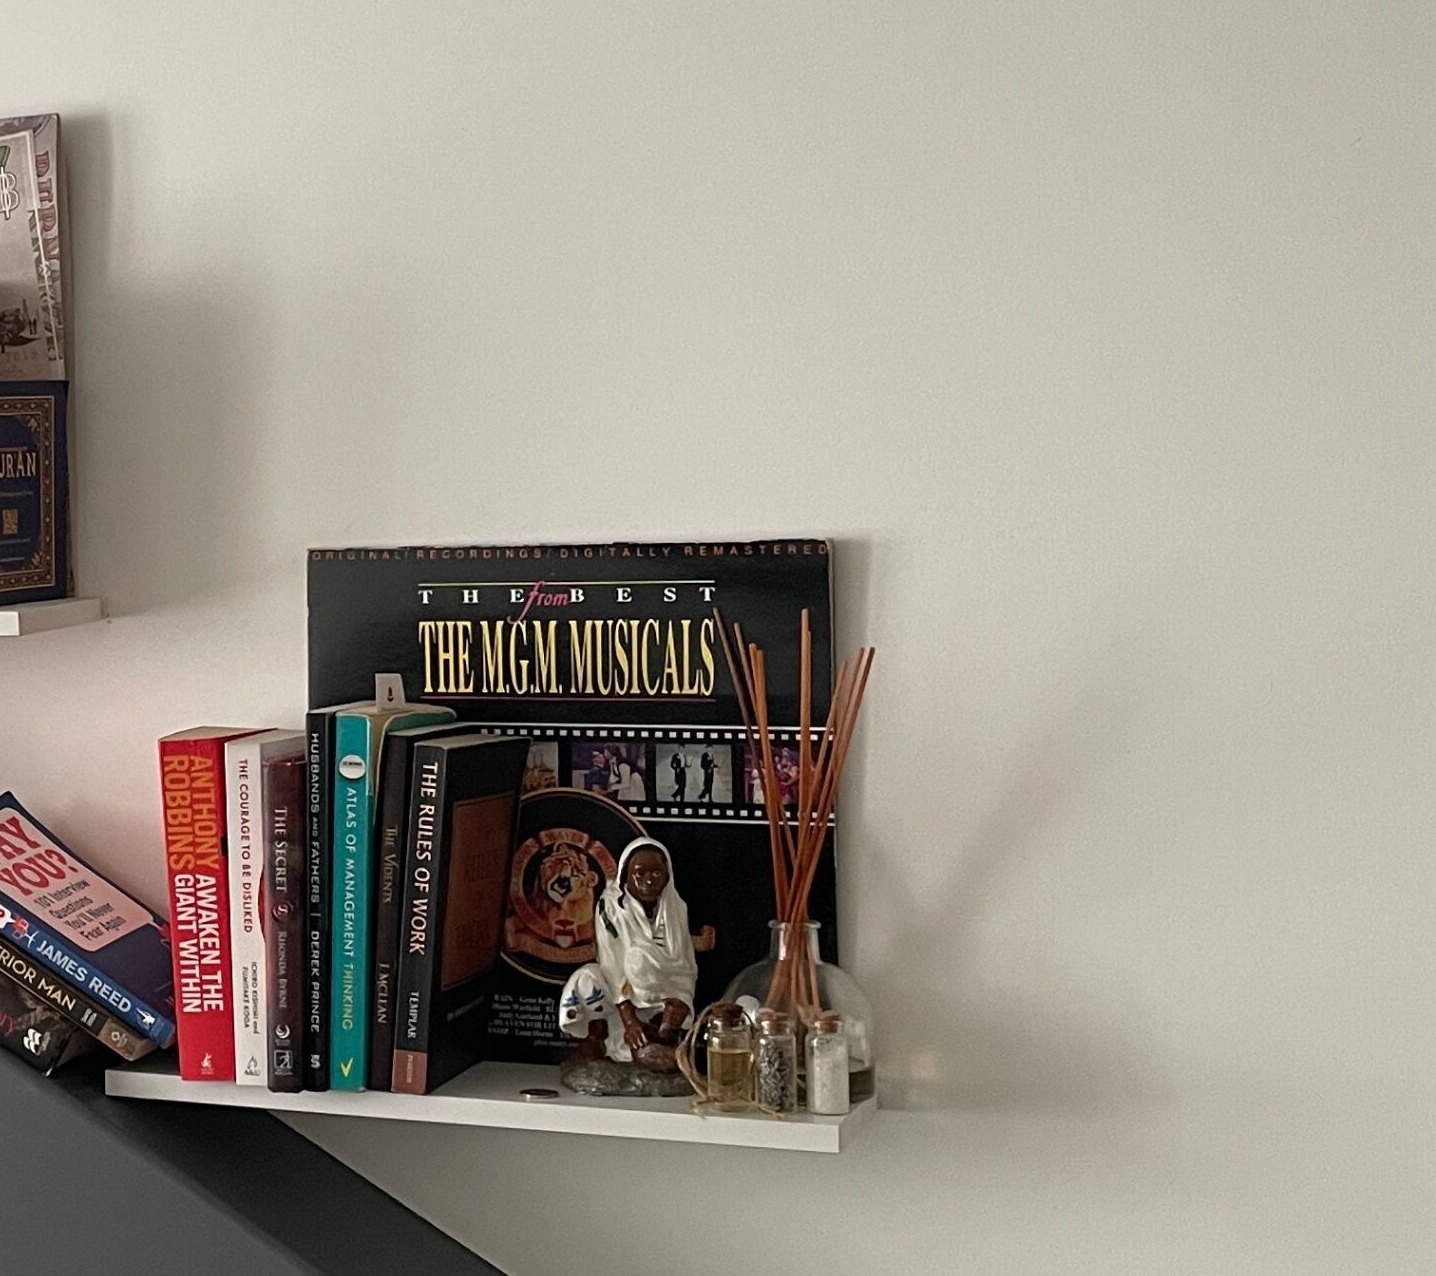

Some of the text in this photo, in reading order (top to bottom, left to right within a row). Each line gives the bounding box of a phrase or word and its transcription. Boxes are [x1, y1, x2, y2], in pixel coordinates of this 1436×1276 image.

[560, 545, 671, 559] DIGITALLY
[684, 544, 828, 558] REMASTERED
[418, 580, 716, 624] THE from BEST
[418, 618, 715, 696] THE M.G.M. MUSICALS
[163, 754, 203, 1013] ROBBINS GIANT WITHIN
[189, 755, 224, 1012] ANTHONY AWAKEN THE
[238, 759, 253, 933] THE COURAGE TO BE DISLIKED
[274, 807, 289, 893] THE SECRET
[310, 733, 320, 1034] HUSBANDS AND FATHERS DEREK PRINCE
[382, 824, 400, 903] THE VIDENTS
[409, 761, 439, 957] THE RULES OF WORK
[49, 895, 94, 920] Questions
[51, 879, 91, 901] Interview
[64, 902, 115, 930] You'll Never
[80, 915, 127, 941] Fear Again
[341, 786, 357, 1031] ATLAS OF MANAGEMENT THINKING
[36, 940, 132, 1014] JAMES REED
[38, 978, 77, 1011] MAN
[277, 930, 288, 1008] RHONDA BYRNE
[407, 991, 420, 1040] TEMPLAR
